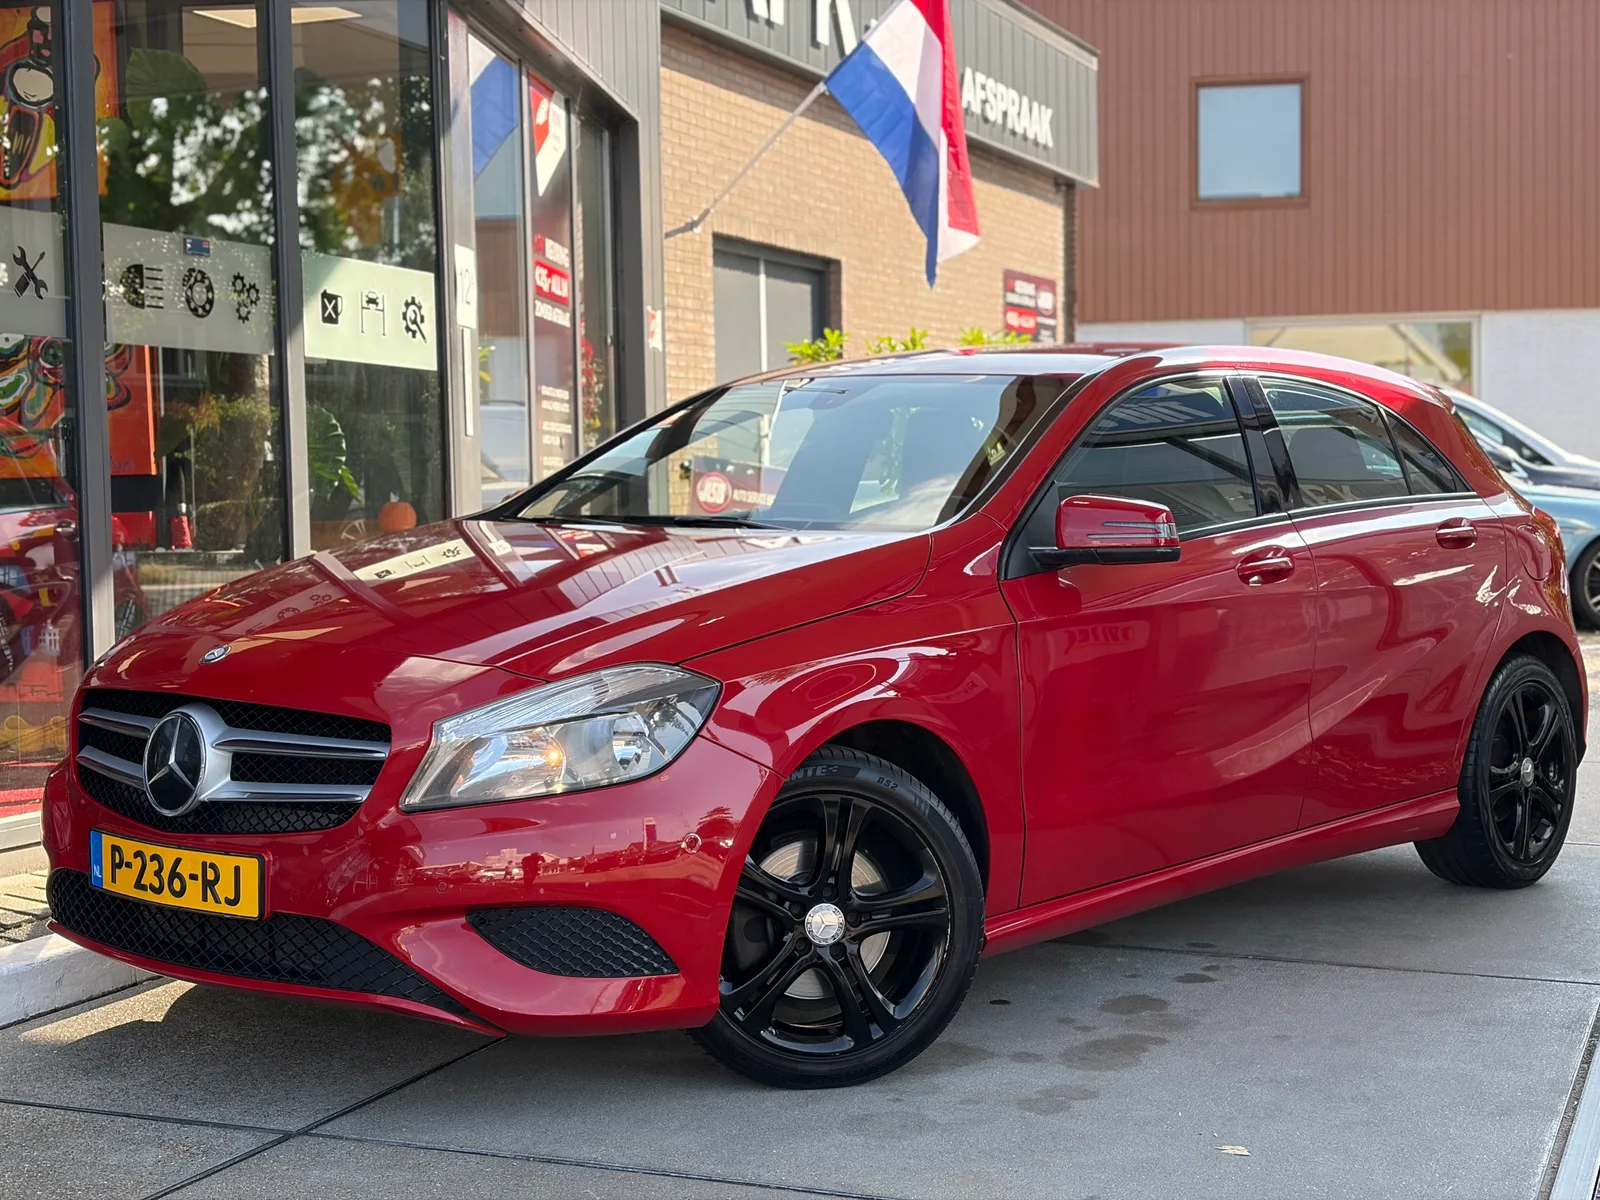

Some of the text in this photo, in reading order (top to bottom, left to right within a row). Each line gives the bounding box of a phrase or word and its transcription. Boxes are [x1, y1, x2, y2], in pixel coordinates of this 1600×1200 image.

[961, 66, 1053, 148] AFSPRAAK
[876, 776, 899, 791] DS2
[93, 864, 102, 878] NL
[110, 844, 241, 907] P-236-RJ
